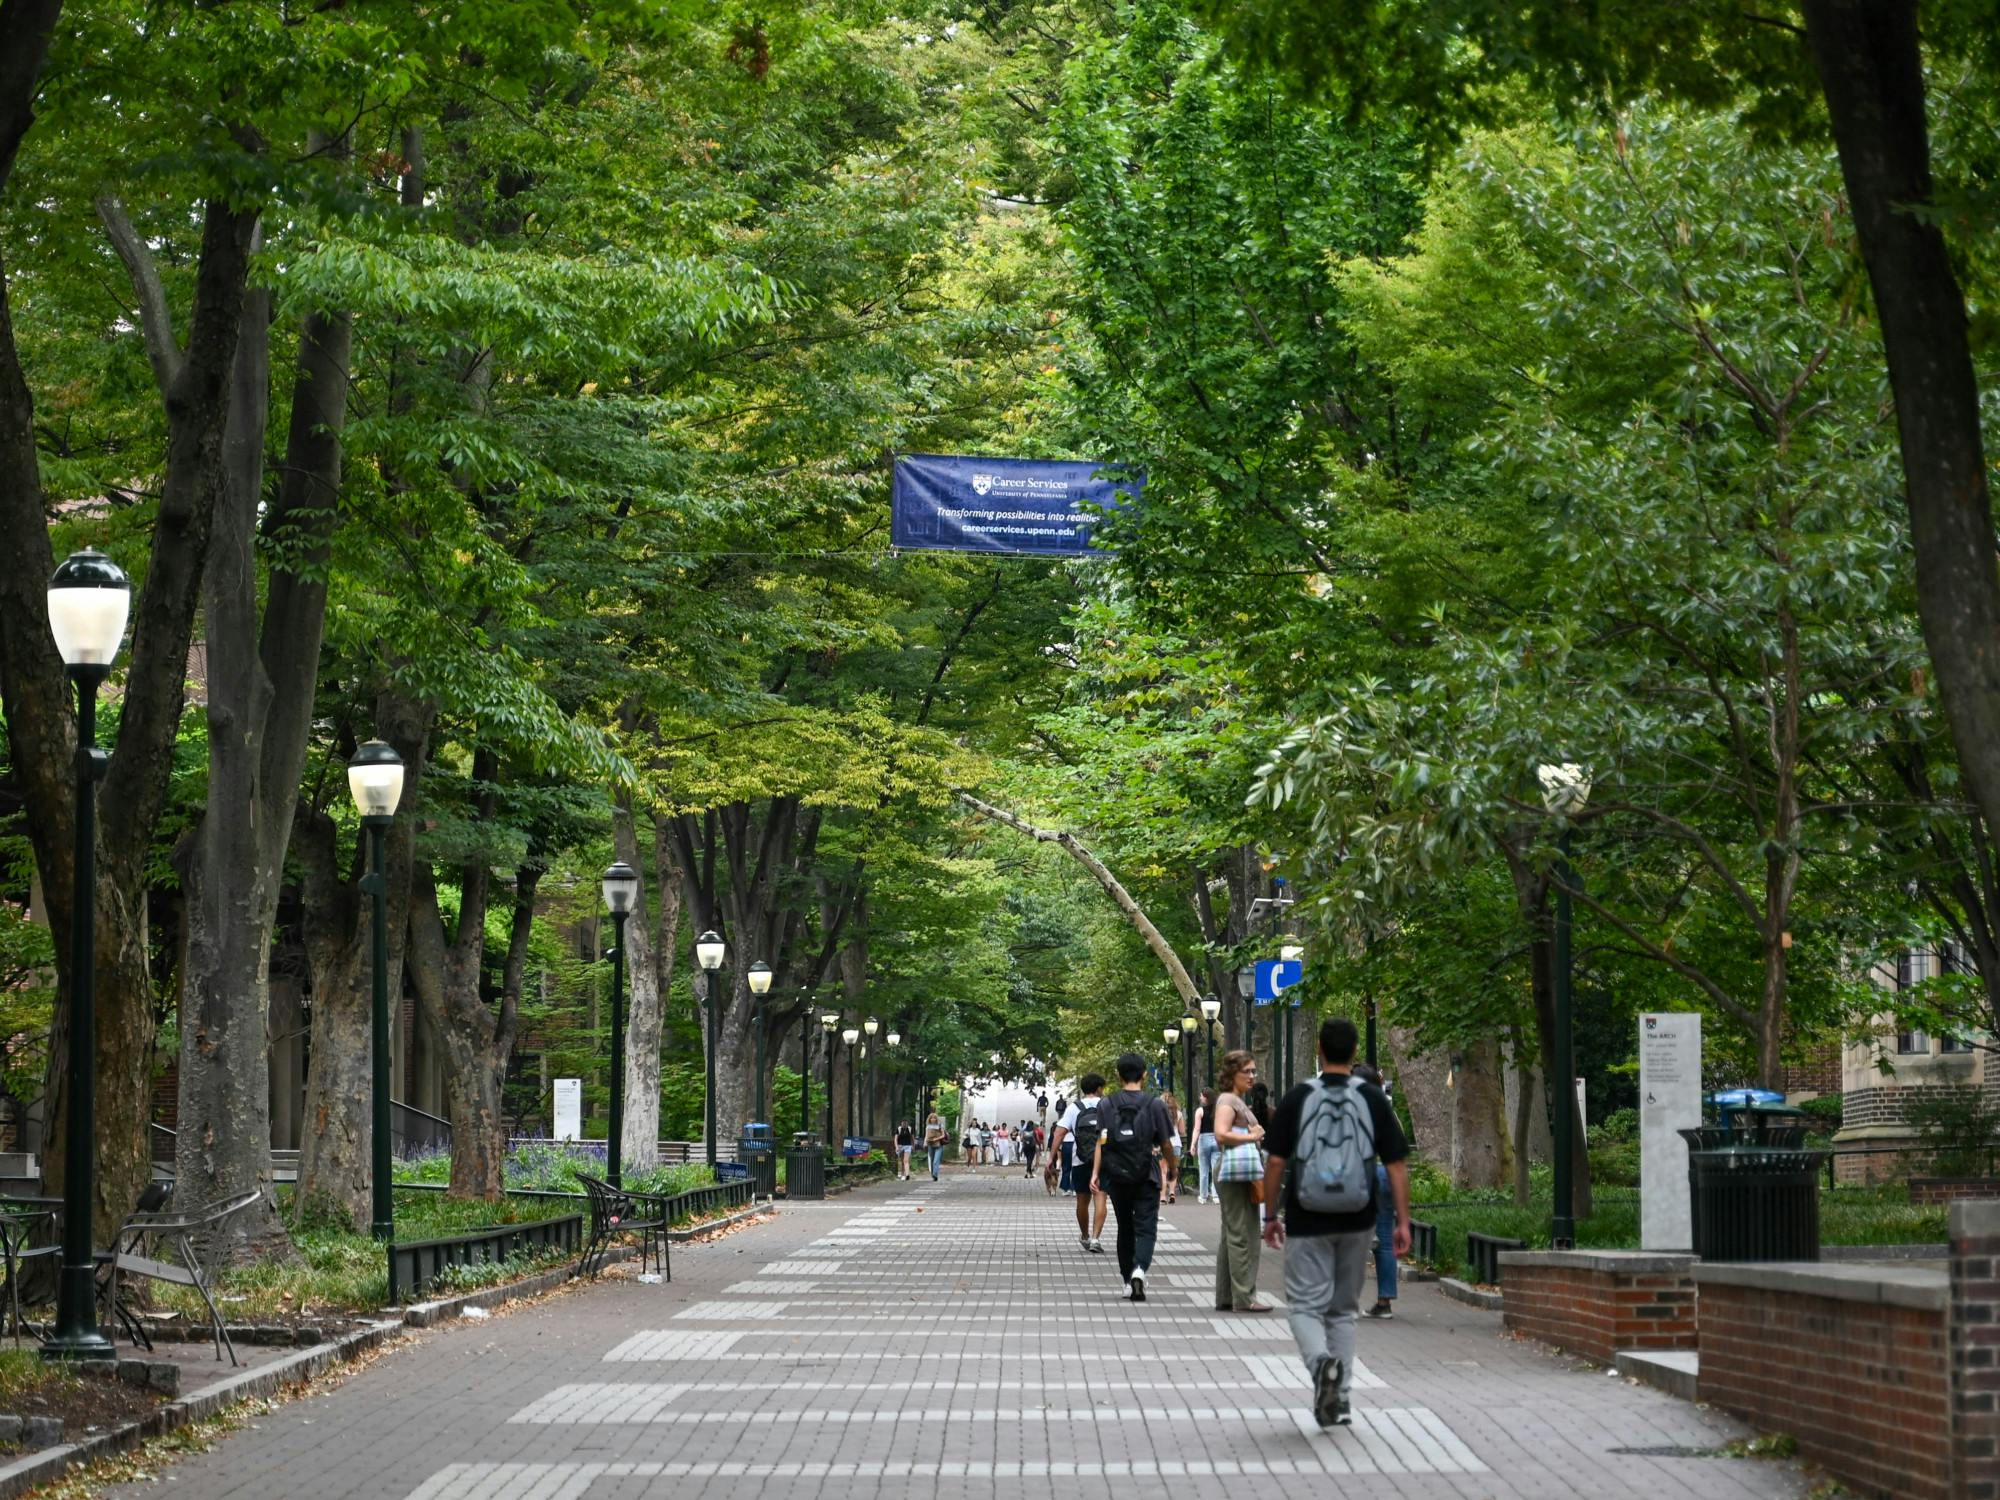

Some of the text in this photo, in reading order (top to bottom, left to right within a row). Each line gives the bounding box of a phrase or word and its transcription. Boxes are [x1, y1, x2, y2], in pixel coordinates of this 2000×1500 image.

[992, 476, 1068, 489] Career Services
[1022, 491, 1029, 499] of
[937, 506, 994, 520] Transforming
[995, 510, 1046, 521] possibilities
[1047, 511, 1065, 521] into
[961, 524, 1075, 536] careerservices.upenn.edu
